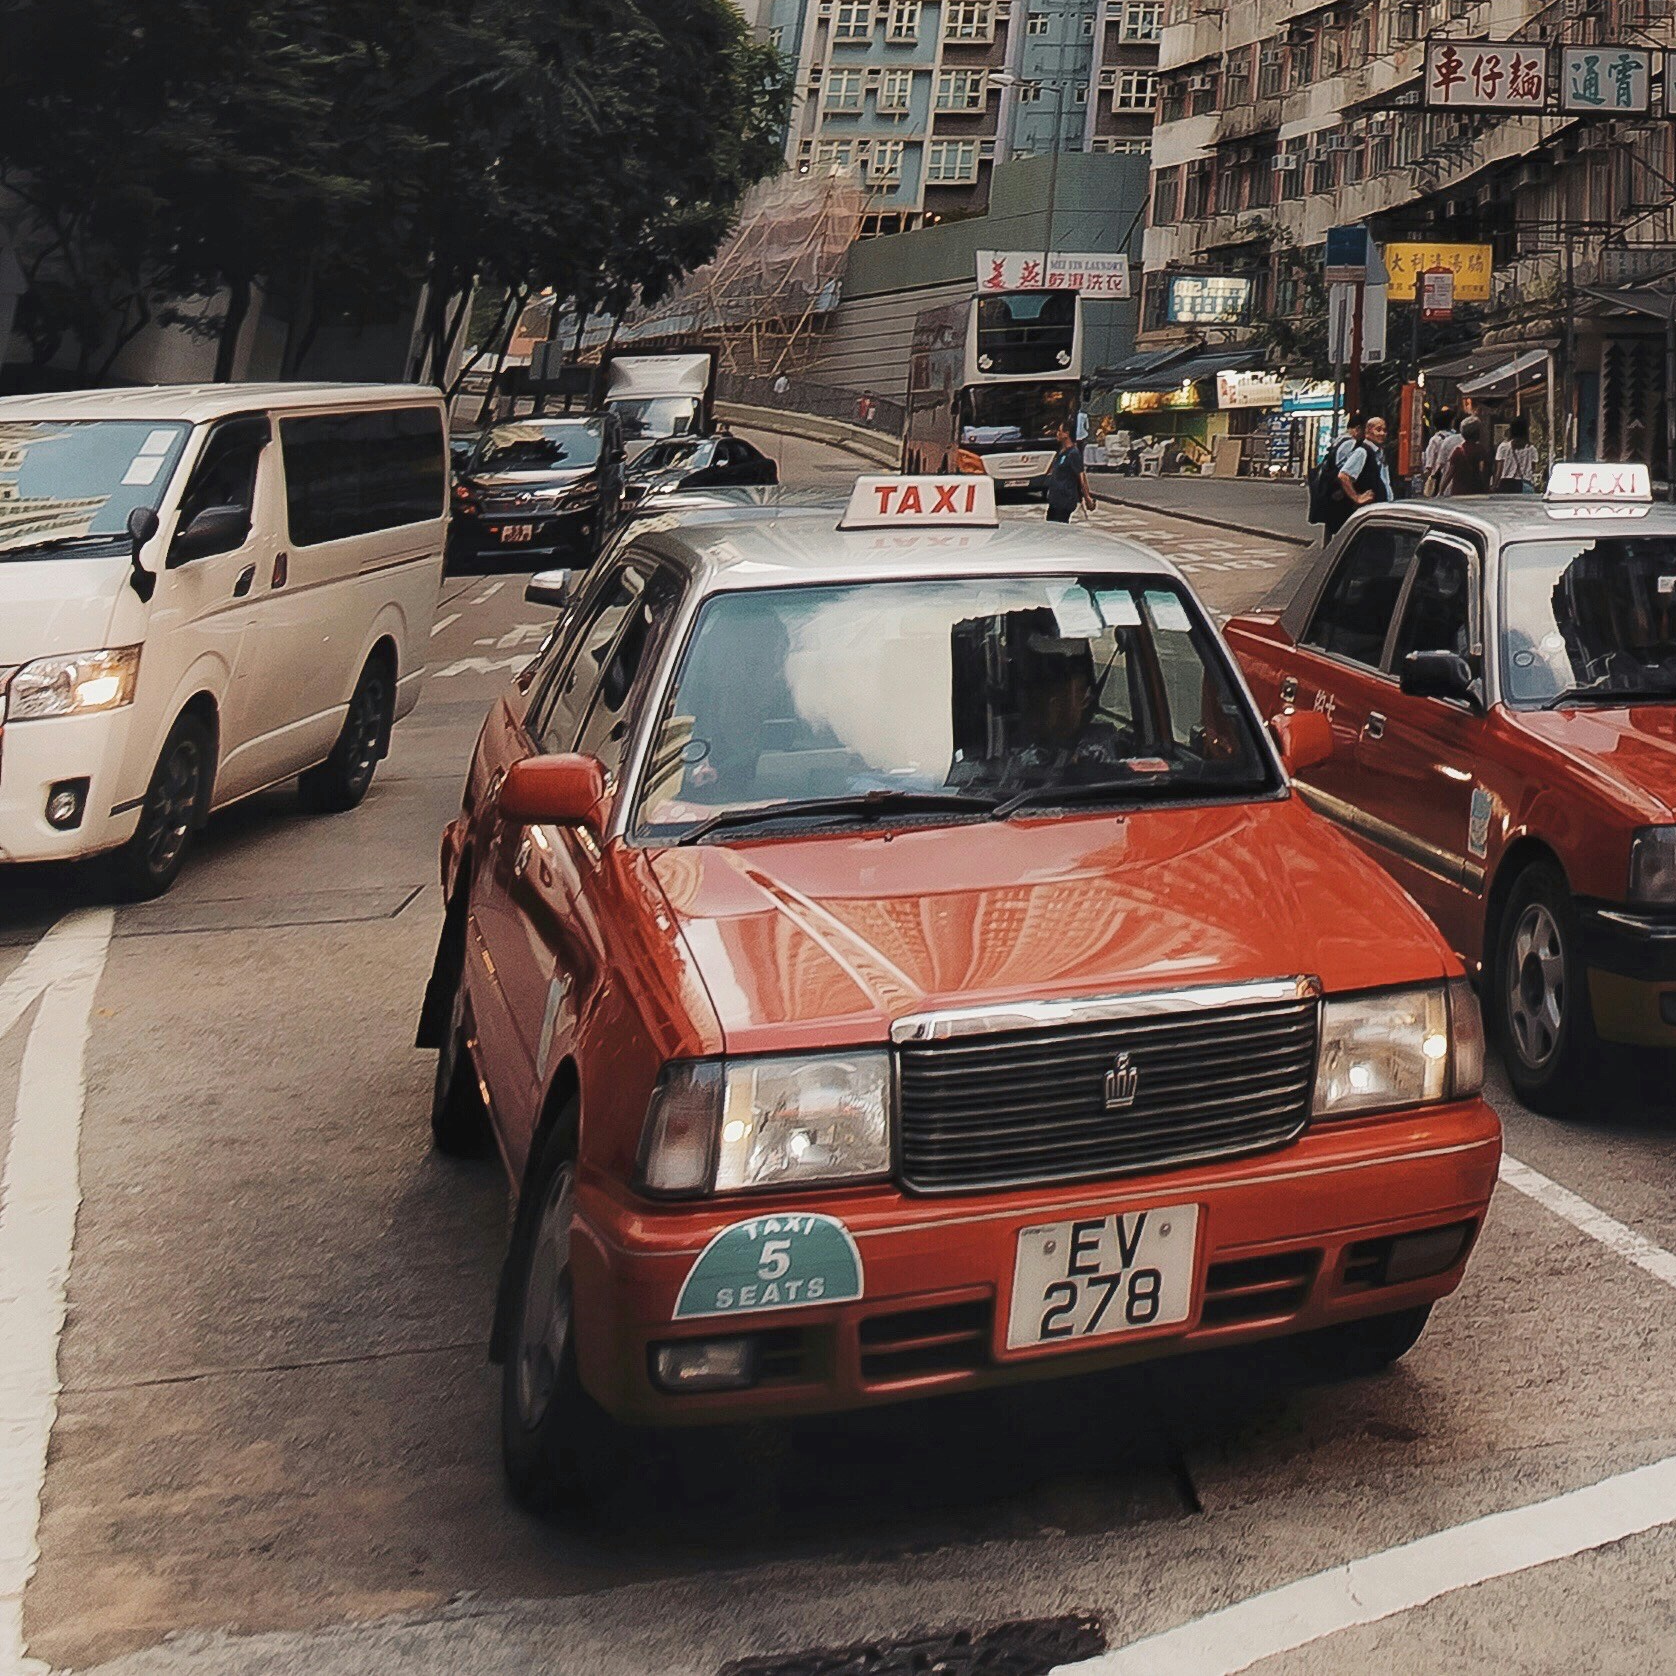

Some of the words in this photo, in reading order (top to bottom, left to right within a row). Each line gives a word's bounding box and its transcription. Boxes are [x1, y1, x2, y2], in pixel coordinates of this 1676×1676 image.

[1432, 45, 1542, 103] 車仔麵
[874, 485, 976, 514] TAXI
[1570, 472, 1635, 494] TAXI
[742, 1217, 816, 1240] TAXI
[1066, 1212, 1148, 1277] EV
[757, 1238, 791, 1281] 5
[715, 1277, 827, 1309] SEATS
[1037, 1268, 1163, 1342] 278
